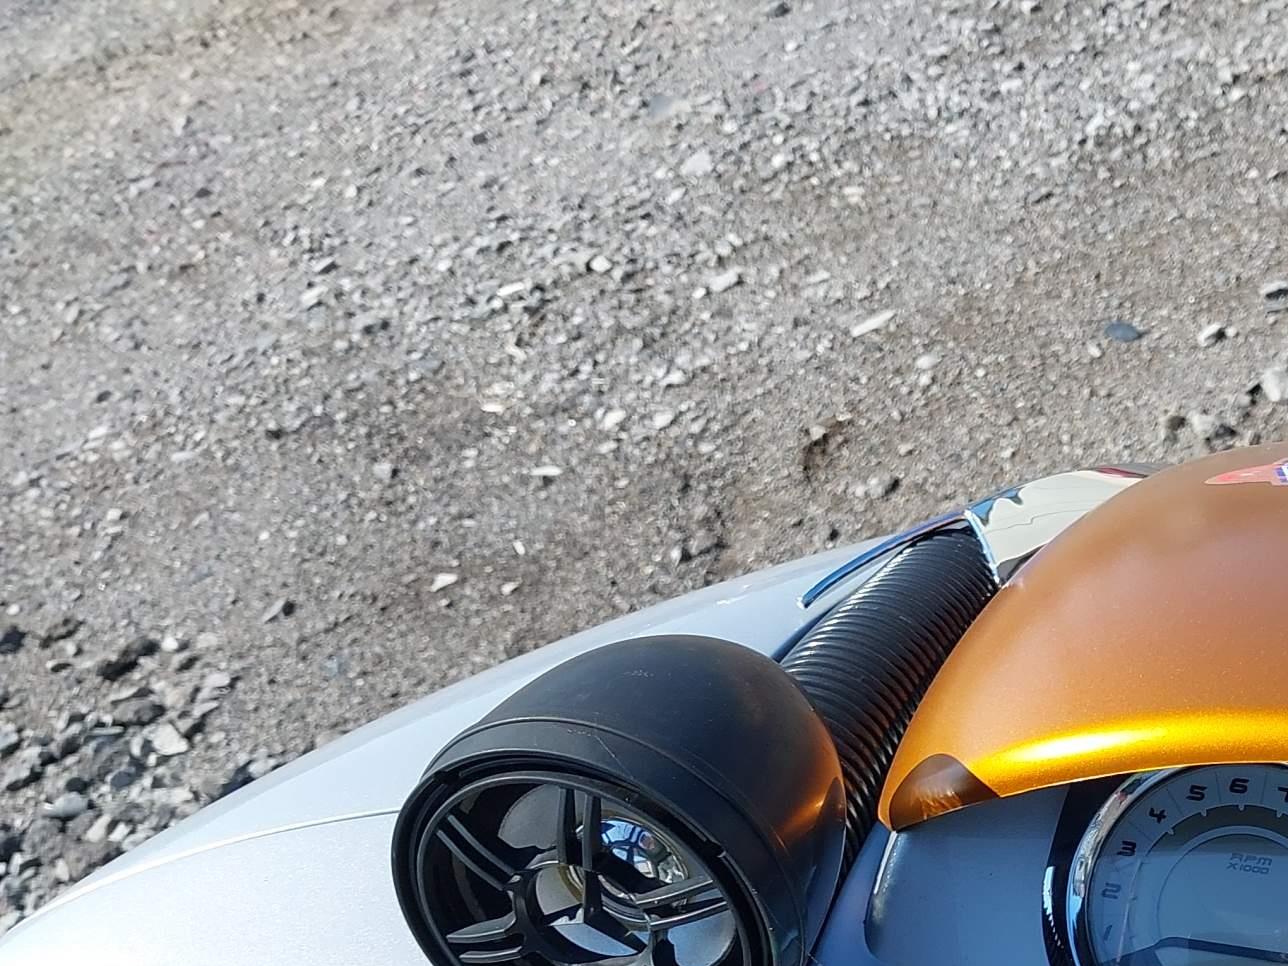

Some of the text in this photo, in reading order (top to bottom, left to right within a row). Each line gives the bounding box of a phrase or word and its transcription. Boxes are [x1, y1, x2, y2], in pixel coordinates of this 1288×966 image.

[1185, 784, 1208, 801] 5
[1229, 777, 1250, 794] 6
[1148, 807, 1167, 824] 4
[1116, 840, 1137, 857] 3
[1229, 852, 1273, 866] RPM
[1101, 882, 1121, 899] 2
